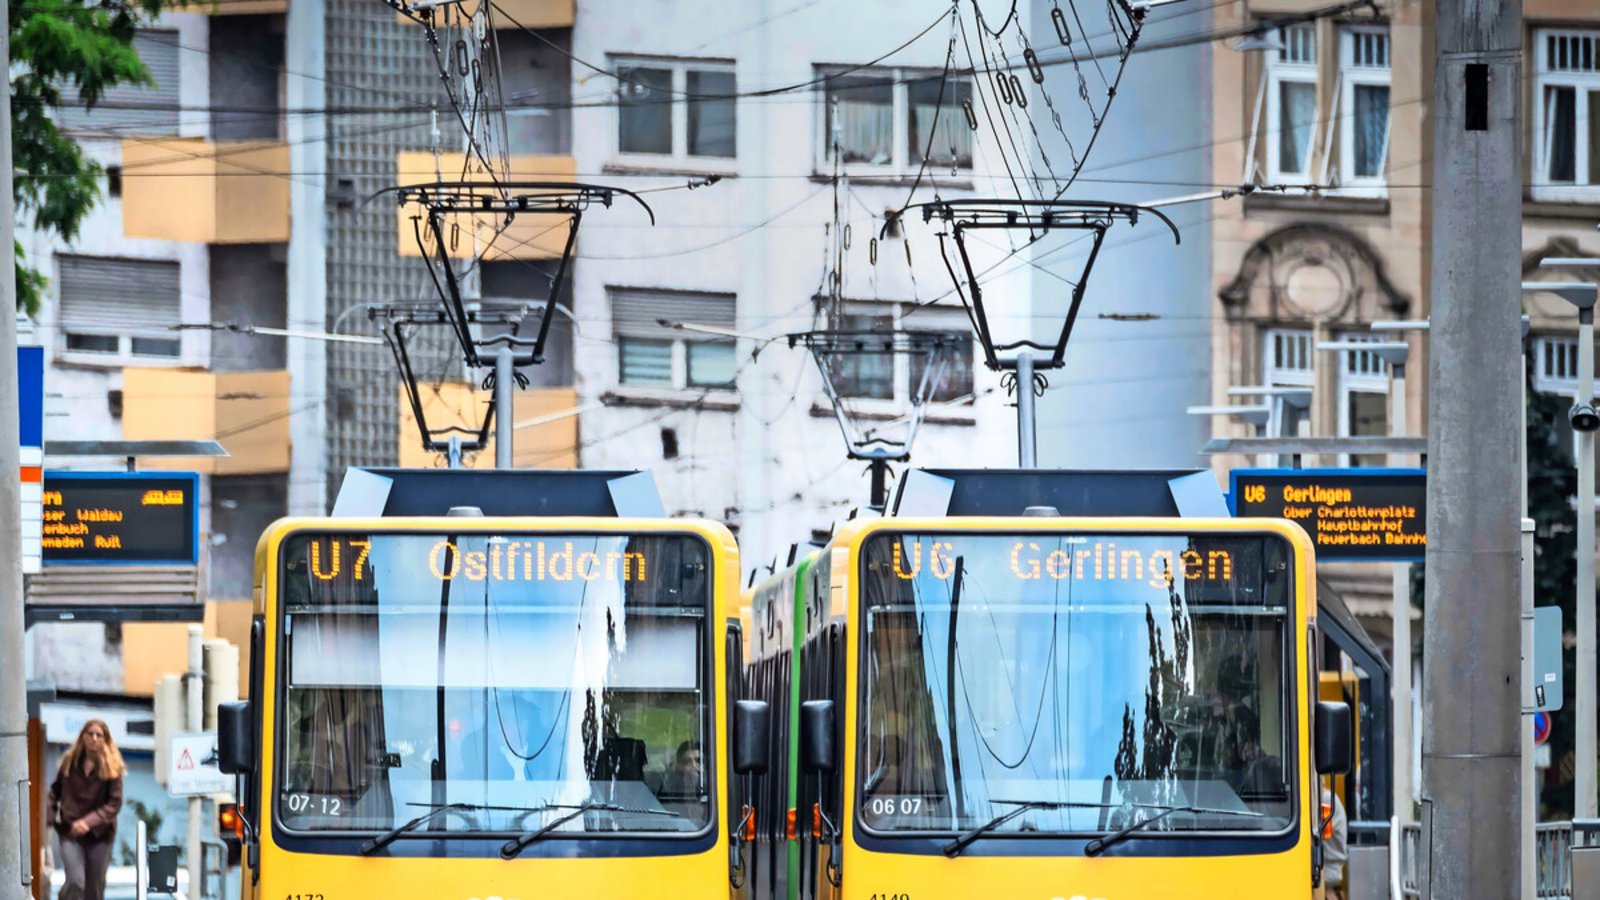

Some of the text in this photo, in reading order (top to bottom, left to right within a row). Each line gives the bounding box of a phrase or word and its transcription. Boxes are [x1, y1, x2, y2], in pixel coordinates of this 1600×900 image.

[1244, 485, 1352, 506] U6 Gerlingen
[42, 508, 123, 522] ser Waldau
[1317, 504, 1416, 519] Charlottenplatz
[42, 522, 89, 535] enbuch
[1317, 519, 1403, 533] Hauptbahnhof
[1317, 533, 1381, 545] Feuerbach
[311, 541, 371, 580] U7
[893, 542, 1231, 588] U6 Gerlingen
[321, 797, 341, 815] 12
[872, 798, 921, 814] 06 07
